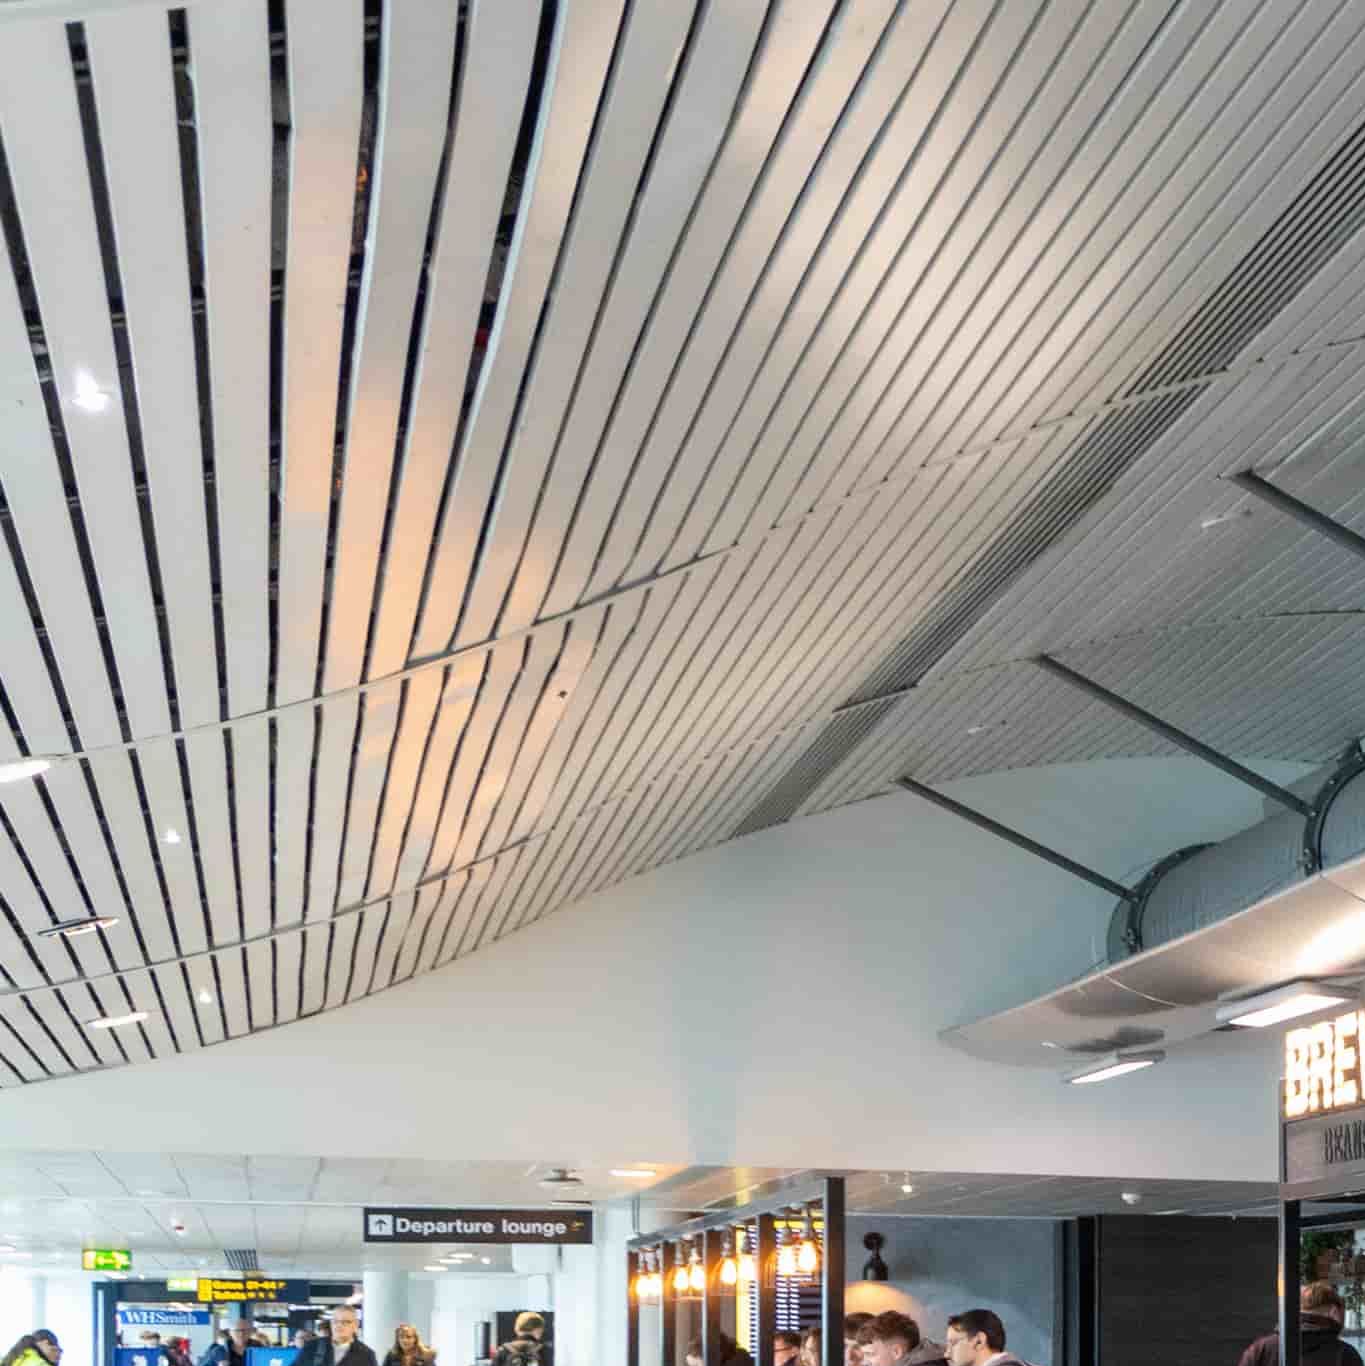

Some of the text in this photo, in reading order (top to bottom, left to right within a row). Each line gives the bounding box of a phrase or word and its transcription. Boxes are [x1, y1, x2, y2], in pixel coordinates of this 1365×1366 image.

[396, 1217, 567, 1237] Departure lounge
[125, 1310, 198, 1325] WHSmith
